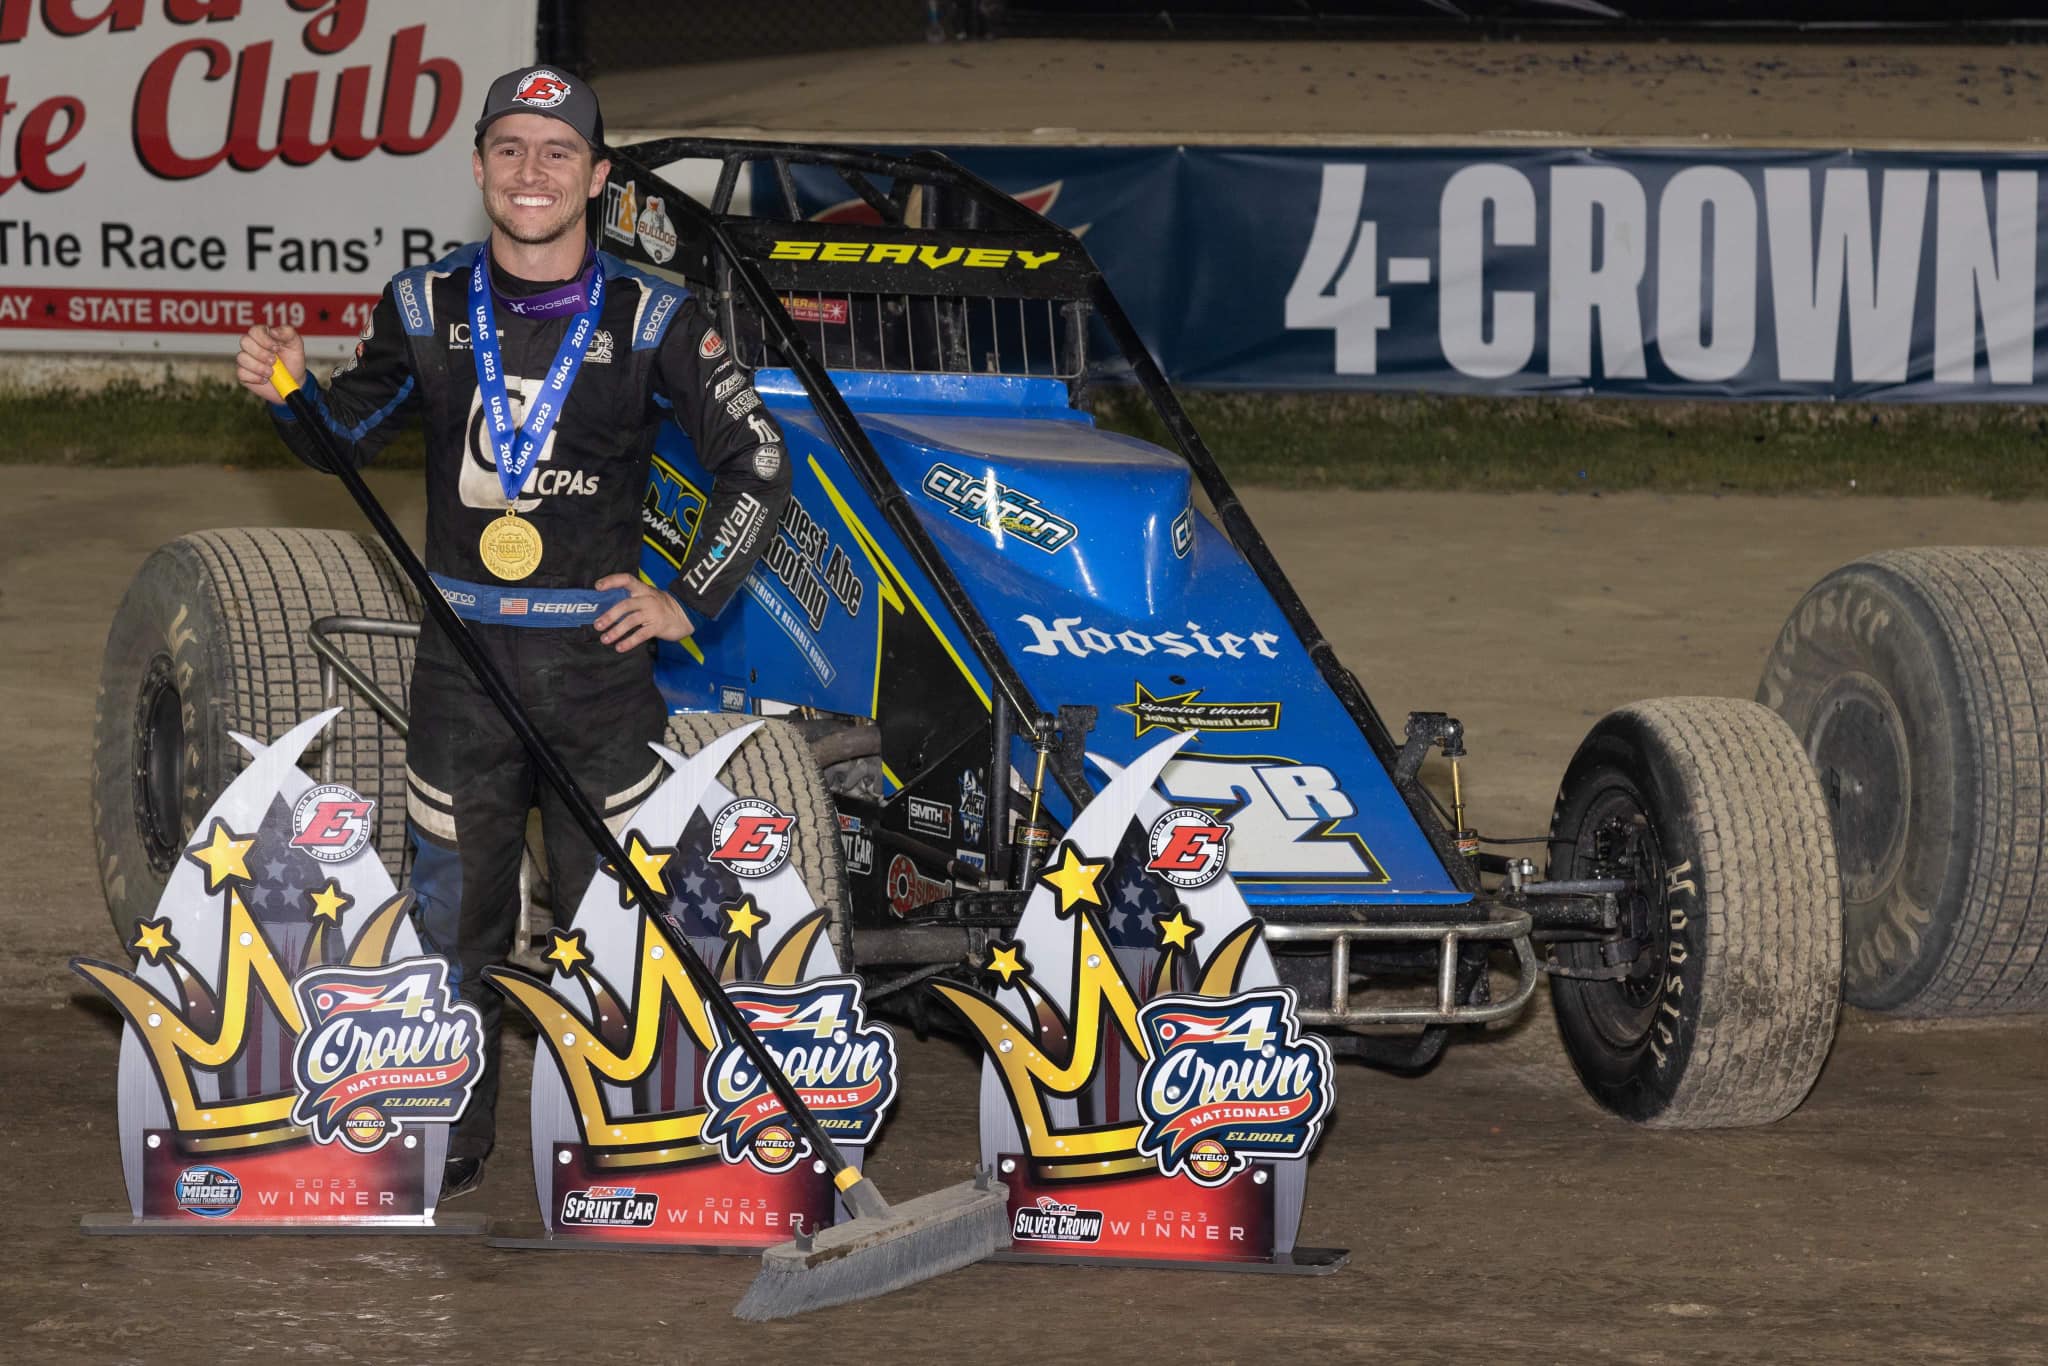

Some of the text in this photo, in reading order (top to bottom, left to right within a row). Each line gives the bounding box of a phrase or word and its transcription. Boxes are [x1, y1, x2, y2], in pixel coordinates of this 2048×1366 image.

[131, 25, 463, 181] Club
[0, 221, 82, 268] The
[101, 222, 227, 270] Race
[402, 229, 472, 269] B
[638, 221, 677, 247] BULLDOG
[768, 240, 1061, 270] SEAVEY
[473, 263, 484, 293] 2023
[1285, 162, 2039, 385] 4-CROWN
[399, 277, 424, 330] sparco
[526, 294, 581, 312] HOOSIER
[589, 274, 603, 307] USAC
[69, 297, 150, 323] STATE
[160, 300, 254, 326] ROUTE
[262, 303, 305, 327] 119
[476, 305, 489, 341] USAC
[642, 294, 674, 342] sparco
[571, 318, 590, 349] 2023
[482, 351, 497, 383] 2023
[549, 356, 573, 390] USAC
[491, 396, 506, 432] USAC
[532, 402, 552, 433] 2023
[500, 442, 514, 474] 2023
[512, 441, 534, 475] USAC
[537, 469, 599, 495] CPAs
[739, 506, 769, 555] Logistics
[499, 543, 523, 553] USAC
[776, 496, 864, 617] nest Abe
[761, 534, 830, 633] oofing
[781, 610, 810, 652] RELIABLE
[809, 645, 830, 681] ROOFER
[1016, 613, 1280, 659] Hoosier
[1138, 702, 1269, 716] Special thanks
[1143, 714, 1176, 724] John
[1235, 718, 1271, 727] Long
[291, 801, 373, 846] E
[295, 787, 356, 832] ELDORA SPEEDWAY
[715, 801, 777, 847] ELDORA SPEEDWAY
[359, 820, 368, 841] OHIO
[710, 815, 793, 861] E
[1151, 810, 1212, 856] ELDORA SPEEDWAY
[779, 835, 788, 857] OHIO
[854, 834, 872, 865] CAR
[1148, 825, 1229, 871] E
[1214, 845, 1224, 867] OHIO
[371, 973, 435, 1019] 4
[782, 994, 847, 1039] 4
[1213, 1006, 1277, 1052] 4
[307, 1017, 471, 1085] Crown
[346, 1070, 448, 1095] NATIONALS
[1151, 1048, 1314, 1116] Crown
[382, 1097, 452, 1107] ELDORA
[756, 1091, 859, 1114] NAONALS
[1189, 1105, 1290, 1127] NATIONALS
[345, 1120, 386, 1128] NKTELCO
[792, 1119, 864, 1129] DORA
[1225, 1131, 1296, 1143] ELDORA
[754, 1139, 796, 1148] NKTELCO
[1189, 1153, 1230, 1162] NKTELCO
[182, 1171, 209, 1183] NOS
[182, 1185, 238, 1198] MIDGET
[296, 1178, 357, 1189] 2023
[258, 1191, 395, 1206] WINNER
[584, 1187, 636, 1198] AMSOIL
[705, 1197, 768, 1209] 2023
[565, 1197, 655, 1220] SPRINT CAR
[667, 1209, 804, 1227] WINNER
[1044, 1204, 1077, 1212] USAC
[1147, 1210, 1208, 1222] 2023
[1016, 1213, 1100, 1236] SILVER CROWN
[1110, 1221, 1245, 1240] WINNER
